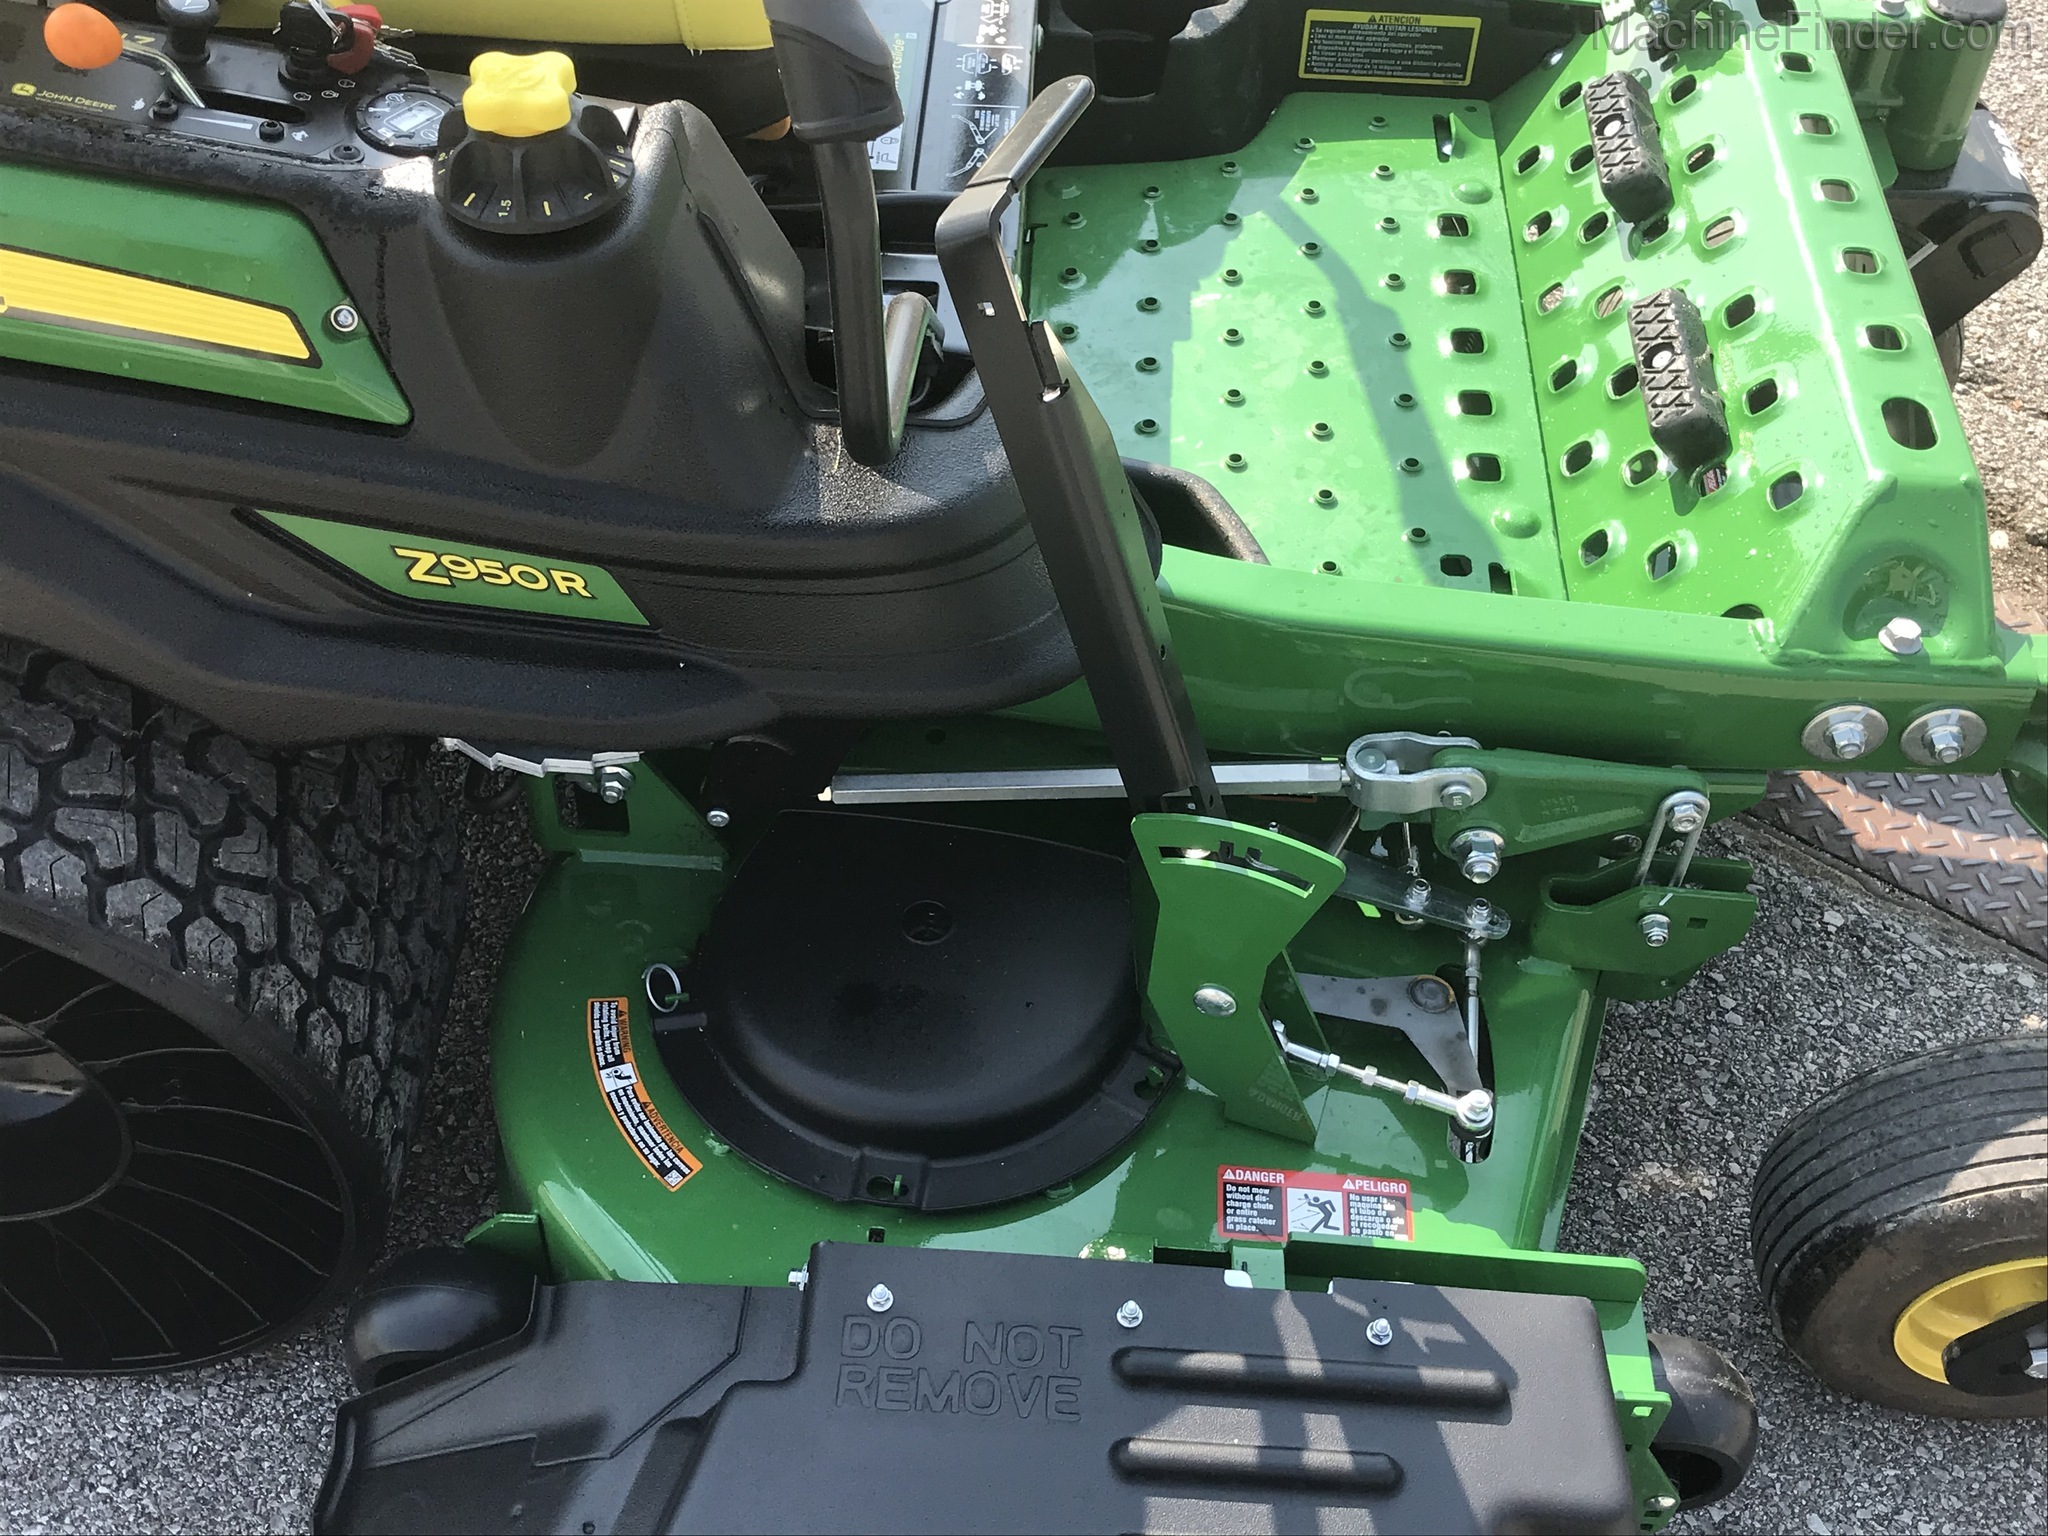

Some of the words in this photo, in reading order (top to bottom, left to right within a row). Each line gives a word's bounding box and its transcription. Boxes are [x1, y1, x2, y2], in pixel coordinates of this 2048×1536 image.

[1378, 16, 1422, 24] ATENCION
[37, 90, 74, 102] JOHN
[74, 96, 118, 111] DEERE
[393, 546, 595, 599] Z950R
[610, 1009, 618, 1024] avoid
[610, 1025, 619, 1041] injury
[619, 1019, 632, 1053] WARNING
[604, 1040, 612, 1054] keep
[612, 1042, 620, 1056] from
[607, 1054, 616, 1062] all
[648, 1108, 684, 1154] ADVERTENCIA
[1235, 1169, 1285, 1184] DANGER
[1355, 1179, 1407, 1194] PELIGRO
[1226, 1192, 1254, 1200] without
[1350, 1193, 1360, 1201] No
[1226, 1200, 1252, 1208] charge
[1252, 1202, 1274, 1210] chute
[1236, 1208, 1258, 1216] entire
[1226, 1216, 1246, 1224] grass
[1248, 1216, 1276, 1226] catcher
[1350, 1214, 1384, 1222] descarga
[1235, 1224, 1259, 1232] place.
[1360, 1222, 1398, 1230] recogedor
[841, 1314, 923, 1361] DO
[963, 1320, 1084, 1370] NOT
[835, 1363, 1082, 1422] REMOVE
